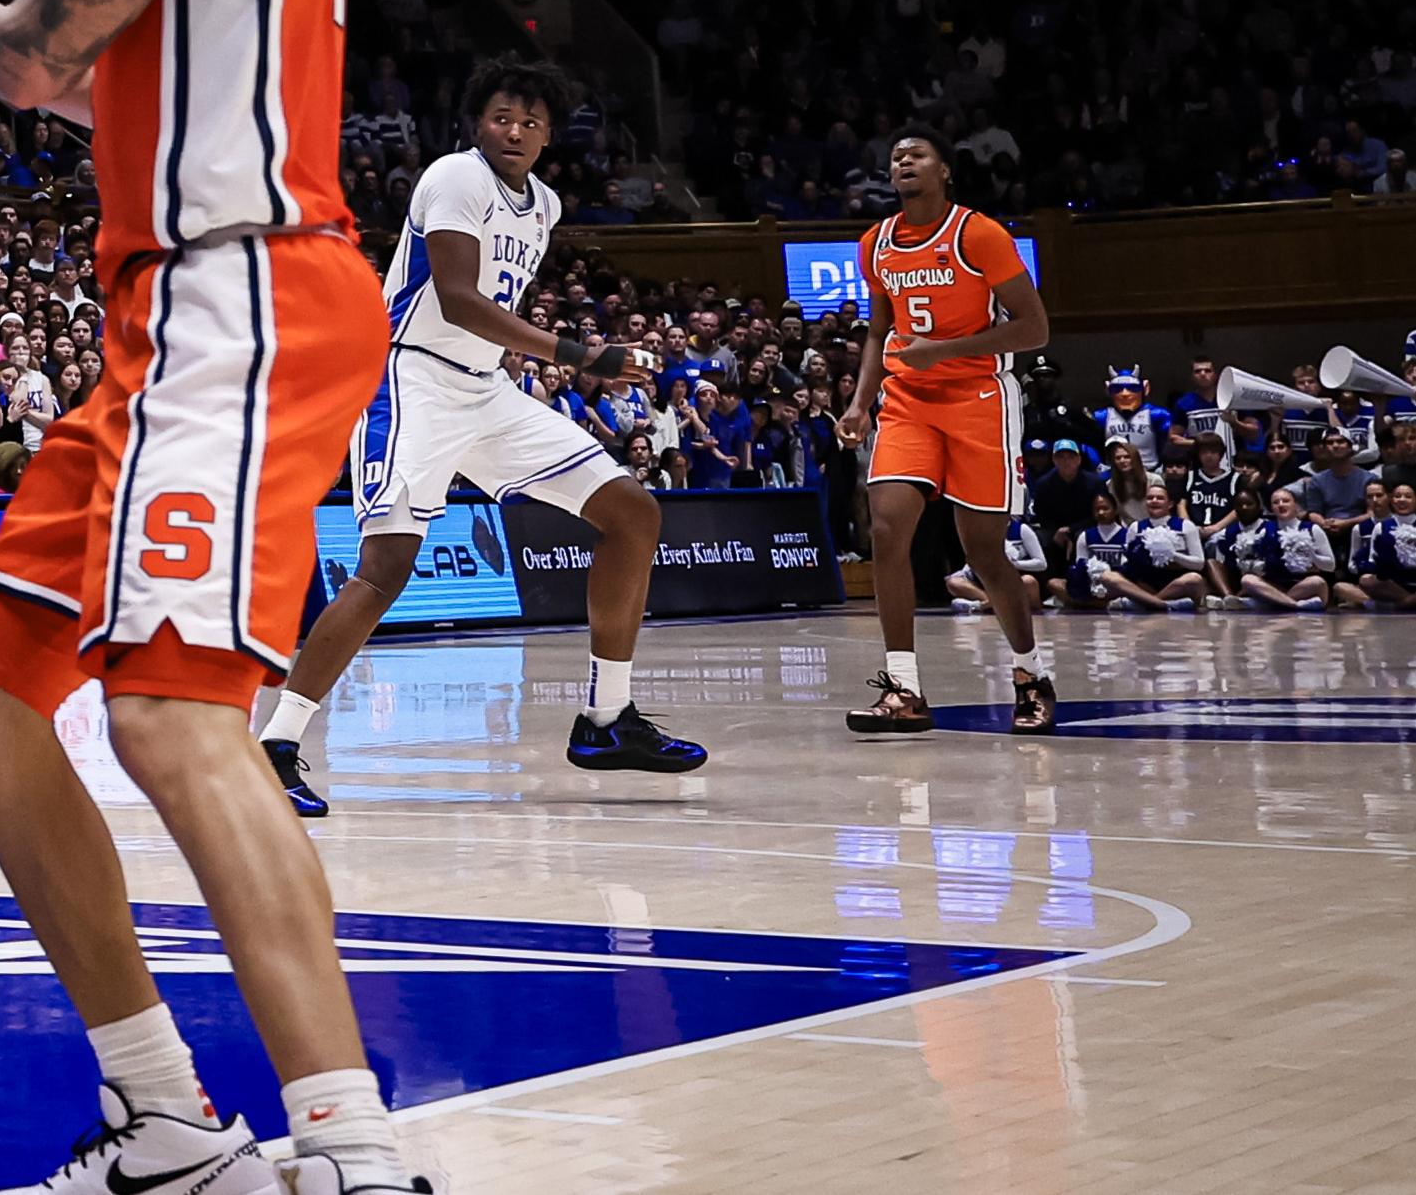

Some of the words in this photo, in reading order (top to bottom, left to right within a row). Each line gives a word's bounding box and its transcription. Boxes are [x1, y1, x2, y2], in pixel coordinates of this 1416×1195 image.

[880, 265, 956, 296] Syracuse
[908, 296, 934, 334] 5
[1110, 423, 1146, 436] DUKE
[364, 460, 382, 485] D
[1191, 490, 1228, 508] Duke
[1203, 508, 1212, 526] 1
[139, 490, 217, 582] S
[774, 532, 809, 544] MARRIOTT
[523, 546, 552, 571] Over
[552, 545, 568, 570] 30
[661, 543, 692, 570] Every
[694, 543, 721, 565] Kind
[723, 542, 735, 563] of
[735, 541, 756, 563] Fan
[771, 547, 819, 569] BONVOY
